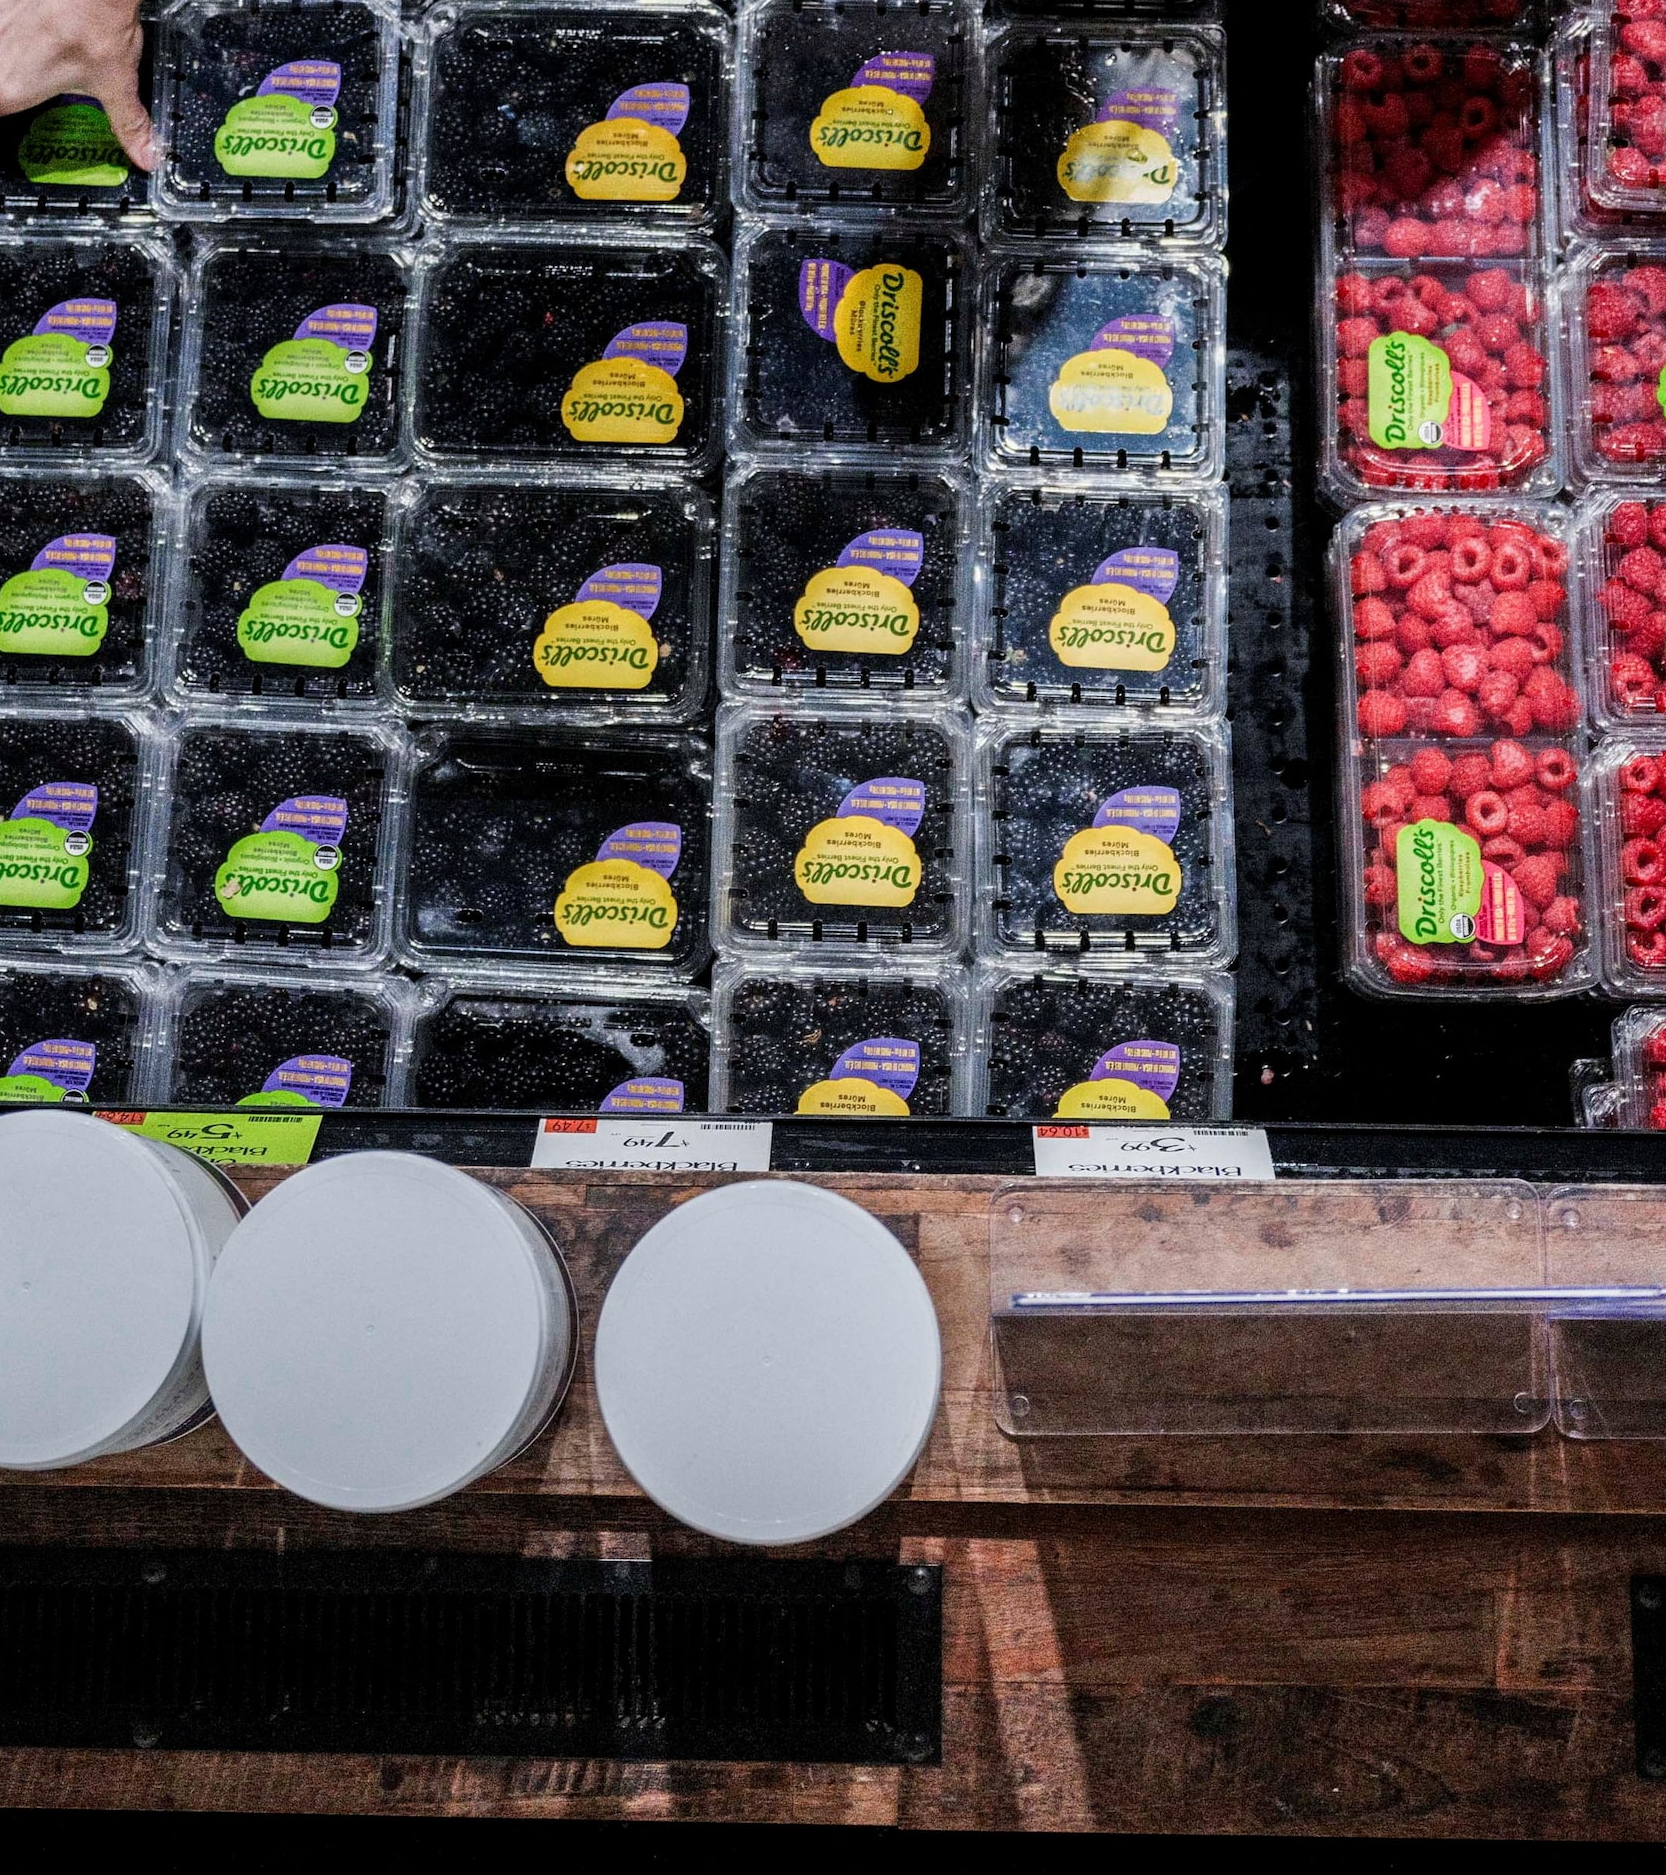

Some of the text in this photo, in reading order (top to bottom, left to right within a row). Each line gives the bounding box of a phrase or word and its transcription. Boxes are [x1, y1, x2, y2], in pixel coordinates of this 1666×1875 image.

[223, 129, 327, 159] Driscoll's
[816, 126, 923, 151] Driscoll's
[575, 160, 678, 183] Driscoll's
[880, 271, 905, 377] Driscoll's
[252, 376, 360, 403] Driscoll's
[1384, 343, 1406, 443] Driscoll's
[568, 400, 675, 425] Driscoll's
[238, 618, 347, 649] Driscoll's
[802, 609, 909, 637] Driscoll's
[1057, 627, 1166, 652] Driscoll's
[541, 643, 648, 669] Driscoll's
[826, 838, 882, 849] Blackberries
[843, 854, 867, 863] Finest
[882, 855, 899, 865] Only
[797, 861, 912, 889] Driscoll's
[1059, 871, 1172, 895] Driscoll's
[1412, 828, 1438, 938] Driscoll's
[560, 902, 667, 928] Driscoll's
[1039, 1126, 1089, 1138] $10.64
[564, 1160, 738, 1172] Blackberries
[1068, 1164, 1242, 1177] Blackberries
